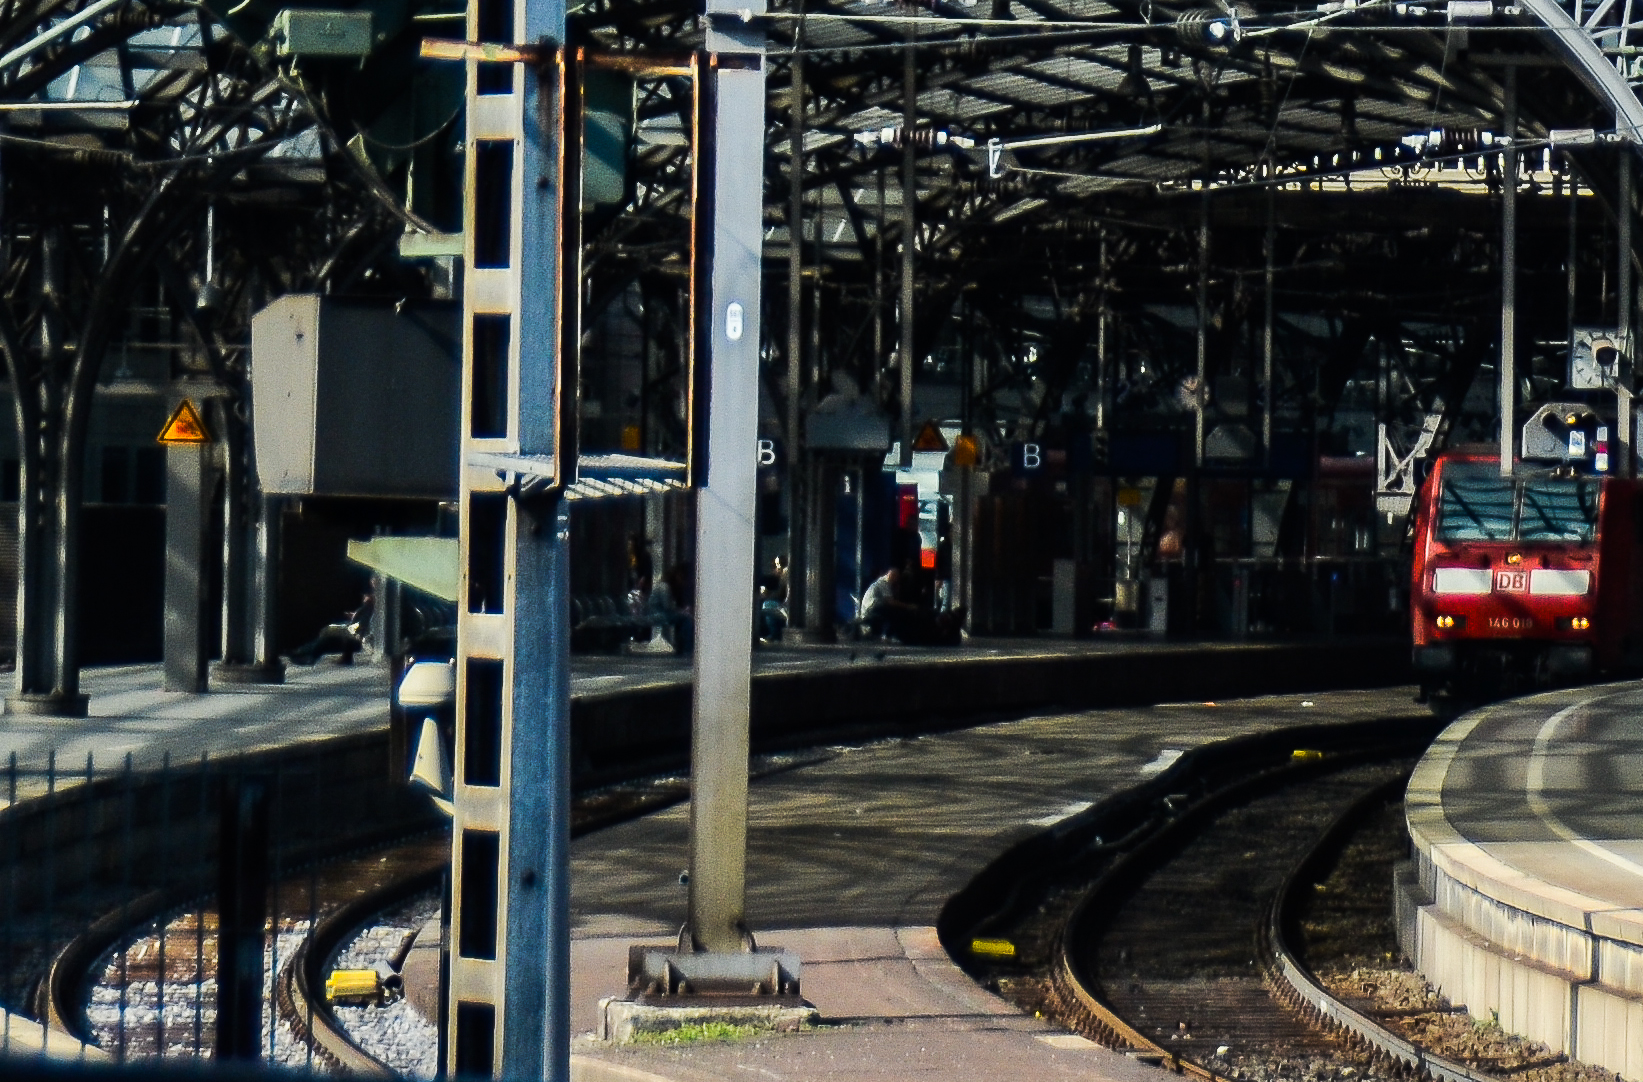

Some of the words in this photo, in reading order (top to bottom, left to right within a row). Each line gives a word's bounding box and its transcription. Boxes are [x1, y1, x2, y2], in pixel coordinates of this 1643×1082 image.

[757, 440, 776, 465] B
[1023, 443, 1041, 468] B
[1498, 573, 1525, 589] DB
